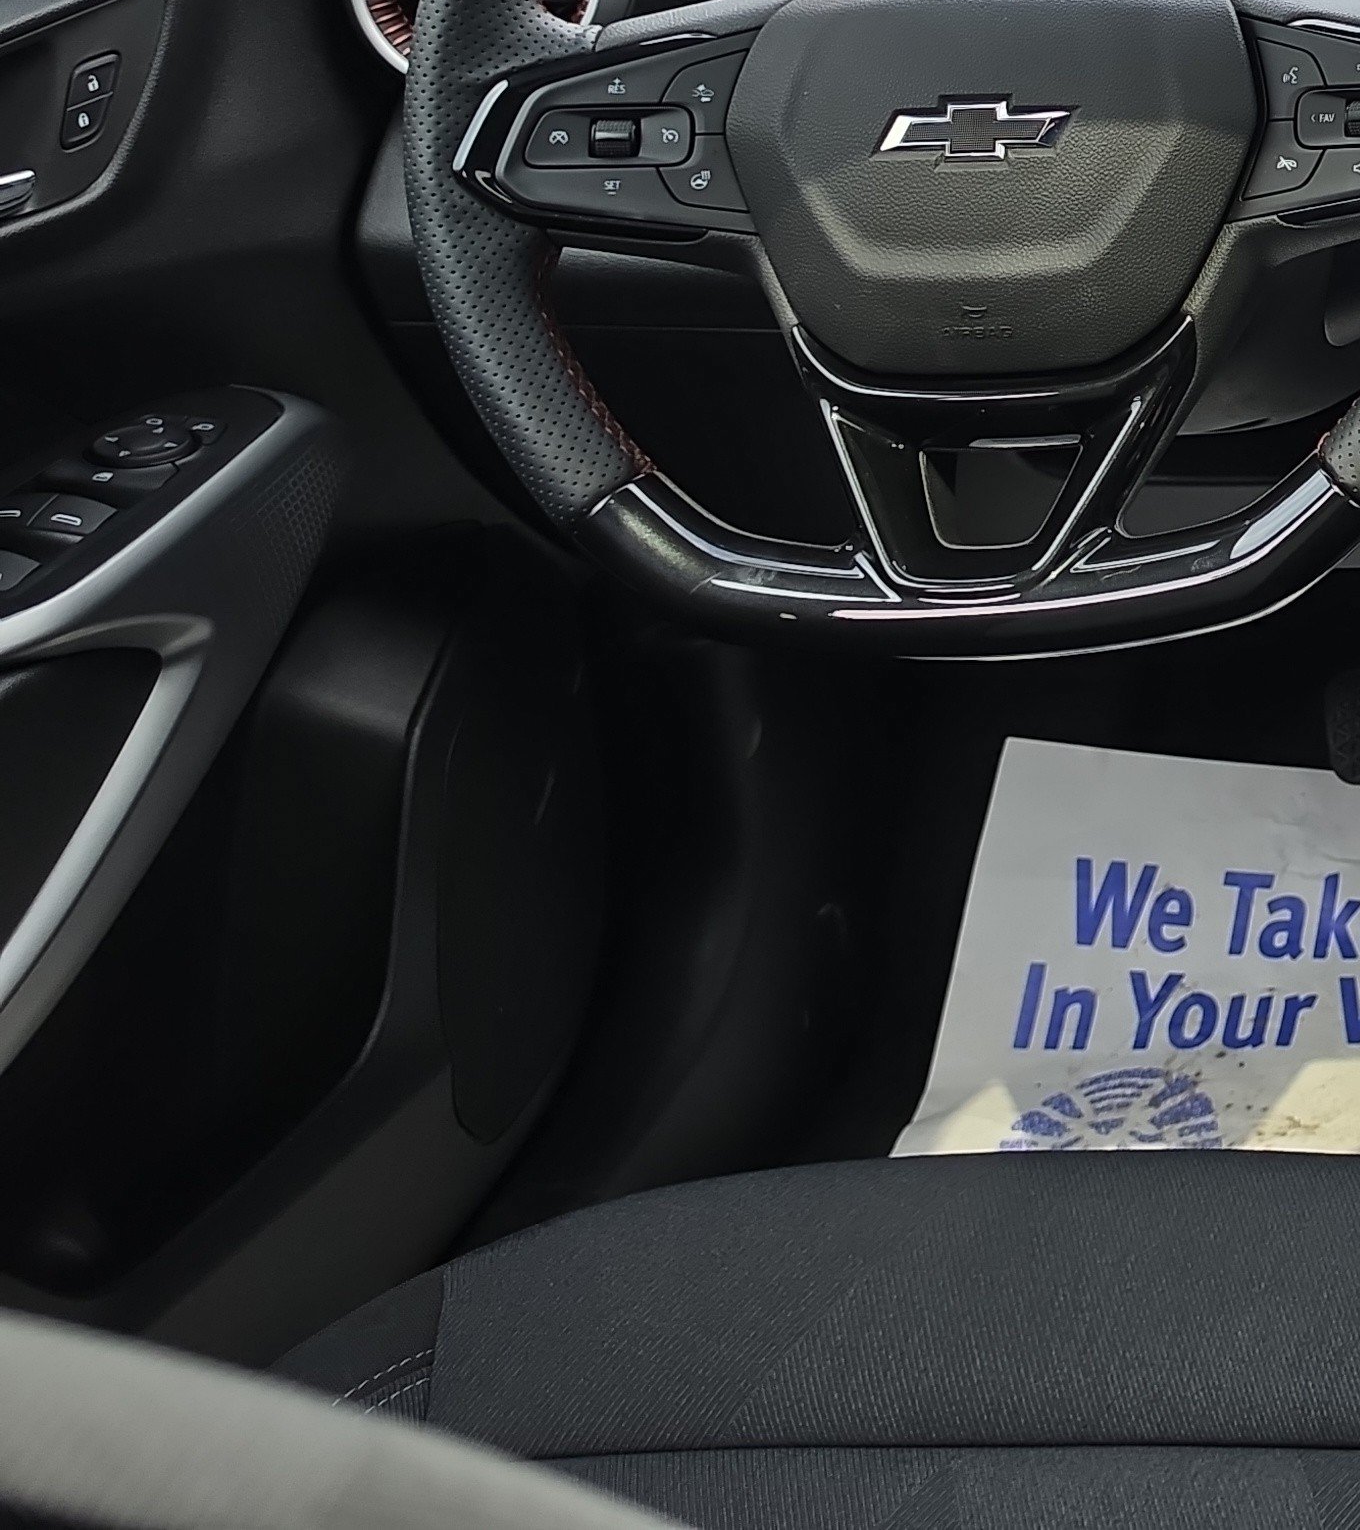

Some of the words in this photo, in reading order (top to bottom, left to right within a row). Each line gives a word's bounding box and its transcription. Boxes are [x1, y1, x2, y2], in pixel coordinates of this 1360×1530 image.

[608, 84, 626, 95] RES
[1319, 113, 1335, 123] FAV
[604, 180, 620, 190] SET
[1074, 857, 1194, 953] We
[1012, 962, 1097, 1050] In
[1131, 971, 1317, 1051] Your
